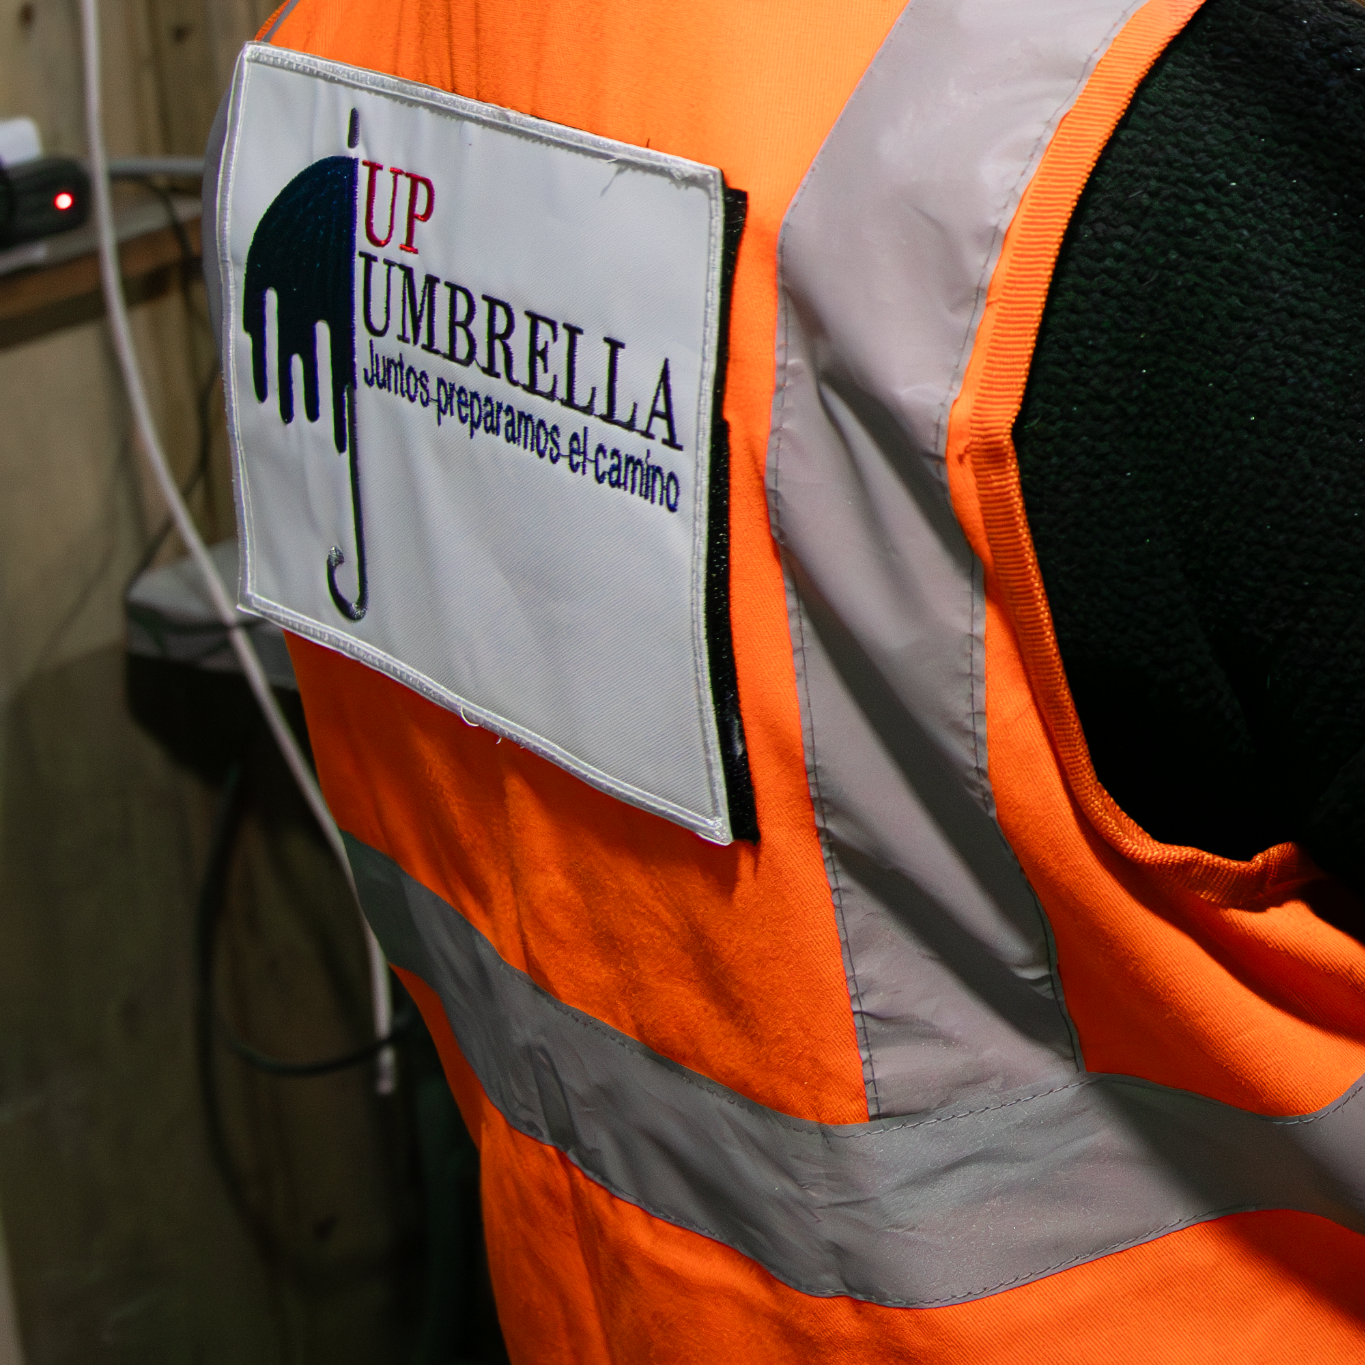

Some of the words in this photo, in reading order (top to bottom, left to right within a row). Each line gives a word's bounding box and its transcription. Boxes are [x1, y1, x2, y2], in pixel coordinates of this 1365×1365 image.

[362, 160, 435, 254] UP
[359, 251, 684, 451] UMBRELLA
[364, 339, 430, 408] Juntos
[436, 376, 561, 465] preparamos
[568, 426, 589, 476] el
[594, 442, 681, 513] camino
